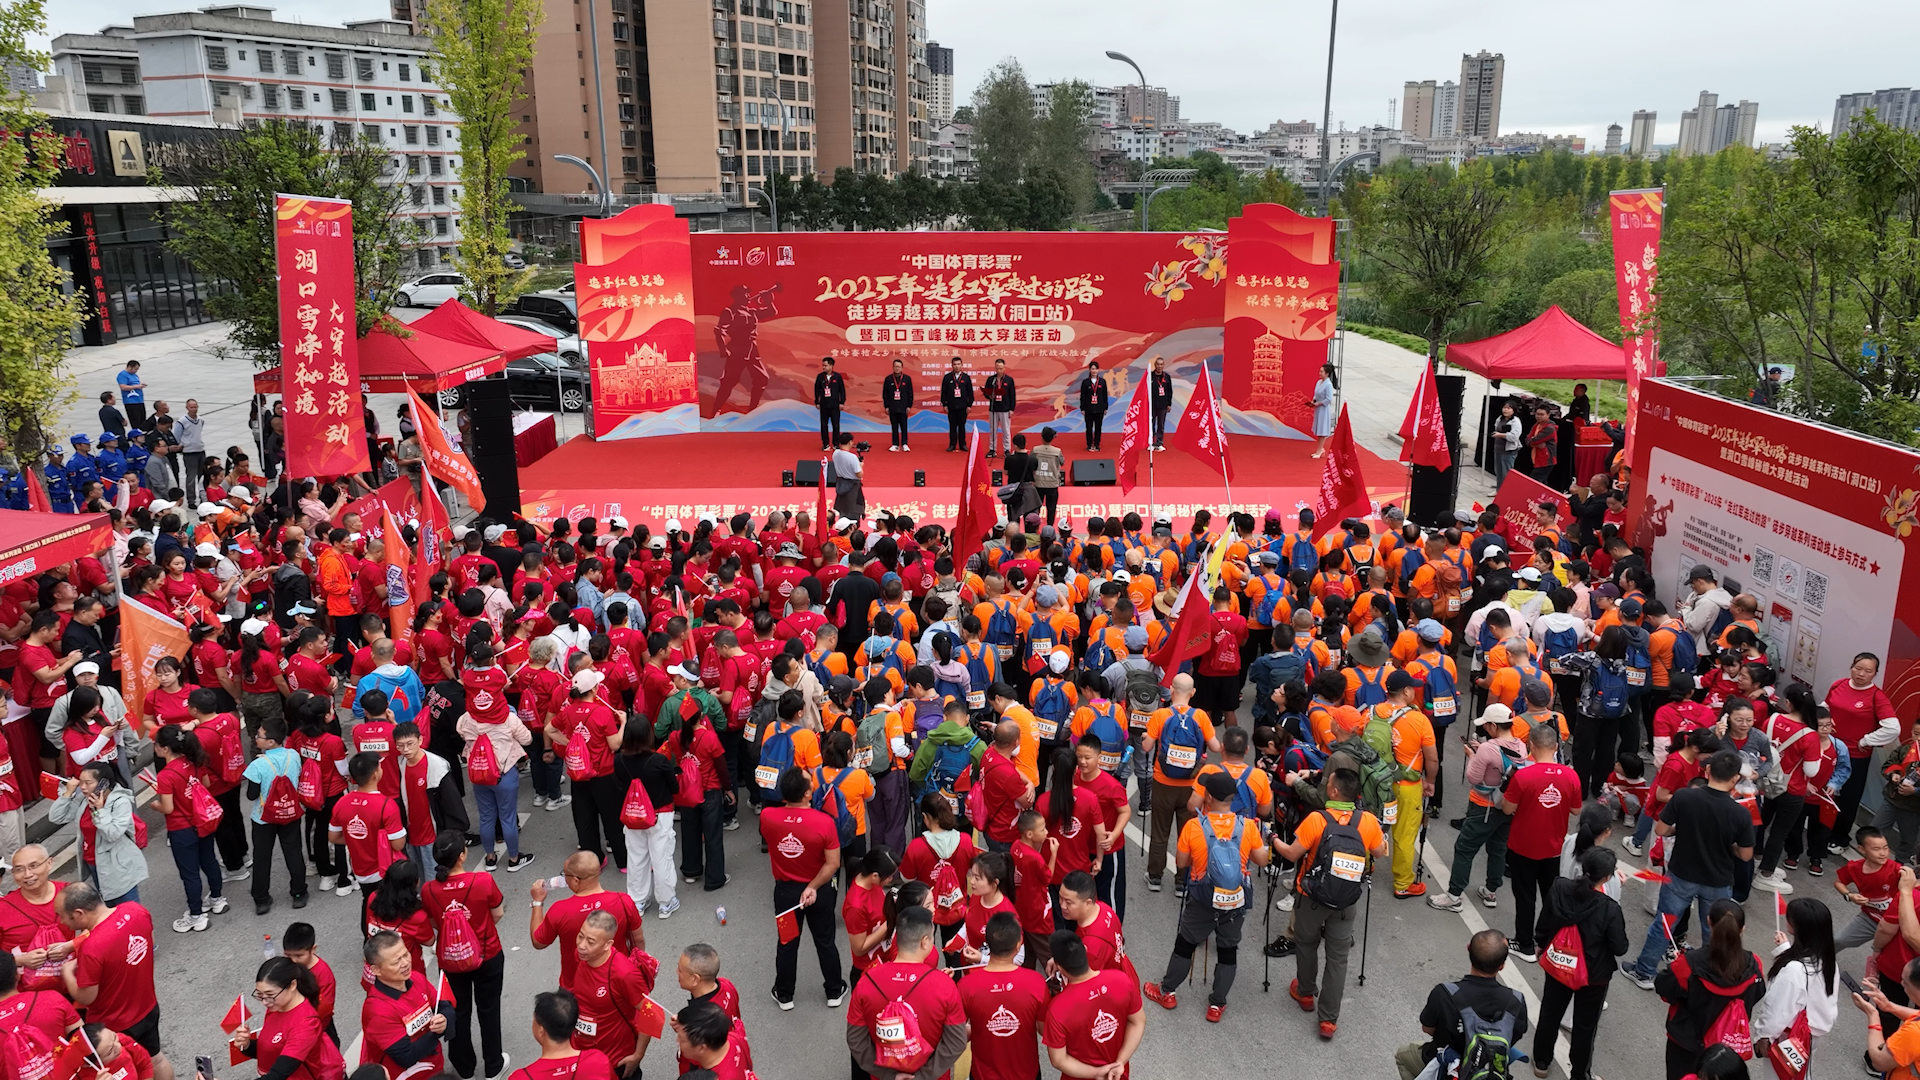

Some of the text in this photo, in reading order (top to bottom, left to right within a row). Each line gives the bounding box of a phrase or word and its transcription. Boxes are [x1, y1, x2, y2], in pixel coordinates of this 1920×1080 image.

[901, 254, 1022, 270] “中国体育彩票”
[847, 304, 1074, 322] 徒步穿越系列活动（洞口站）
[293, 248, 325, 417] 洞口雪峰秘境
[860, 328, 1062, 342] 暨洞口雪峰秘境大穿越活动
[325, 298, 350, 446] 大穿越活动
[1169, 750, 1191, 760] C1265
[1334, 859, 1360, 870] C1242
[1215, 892, 1240, 903] C1241
